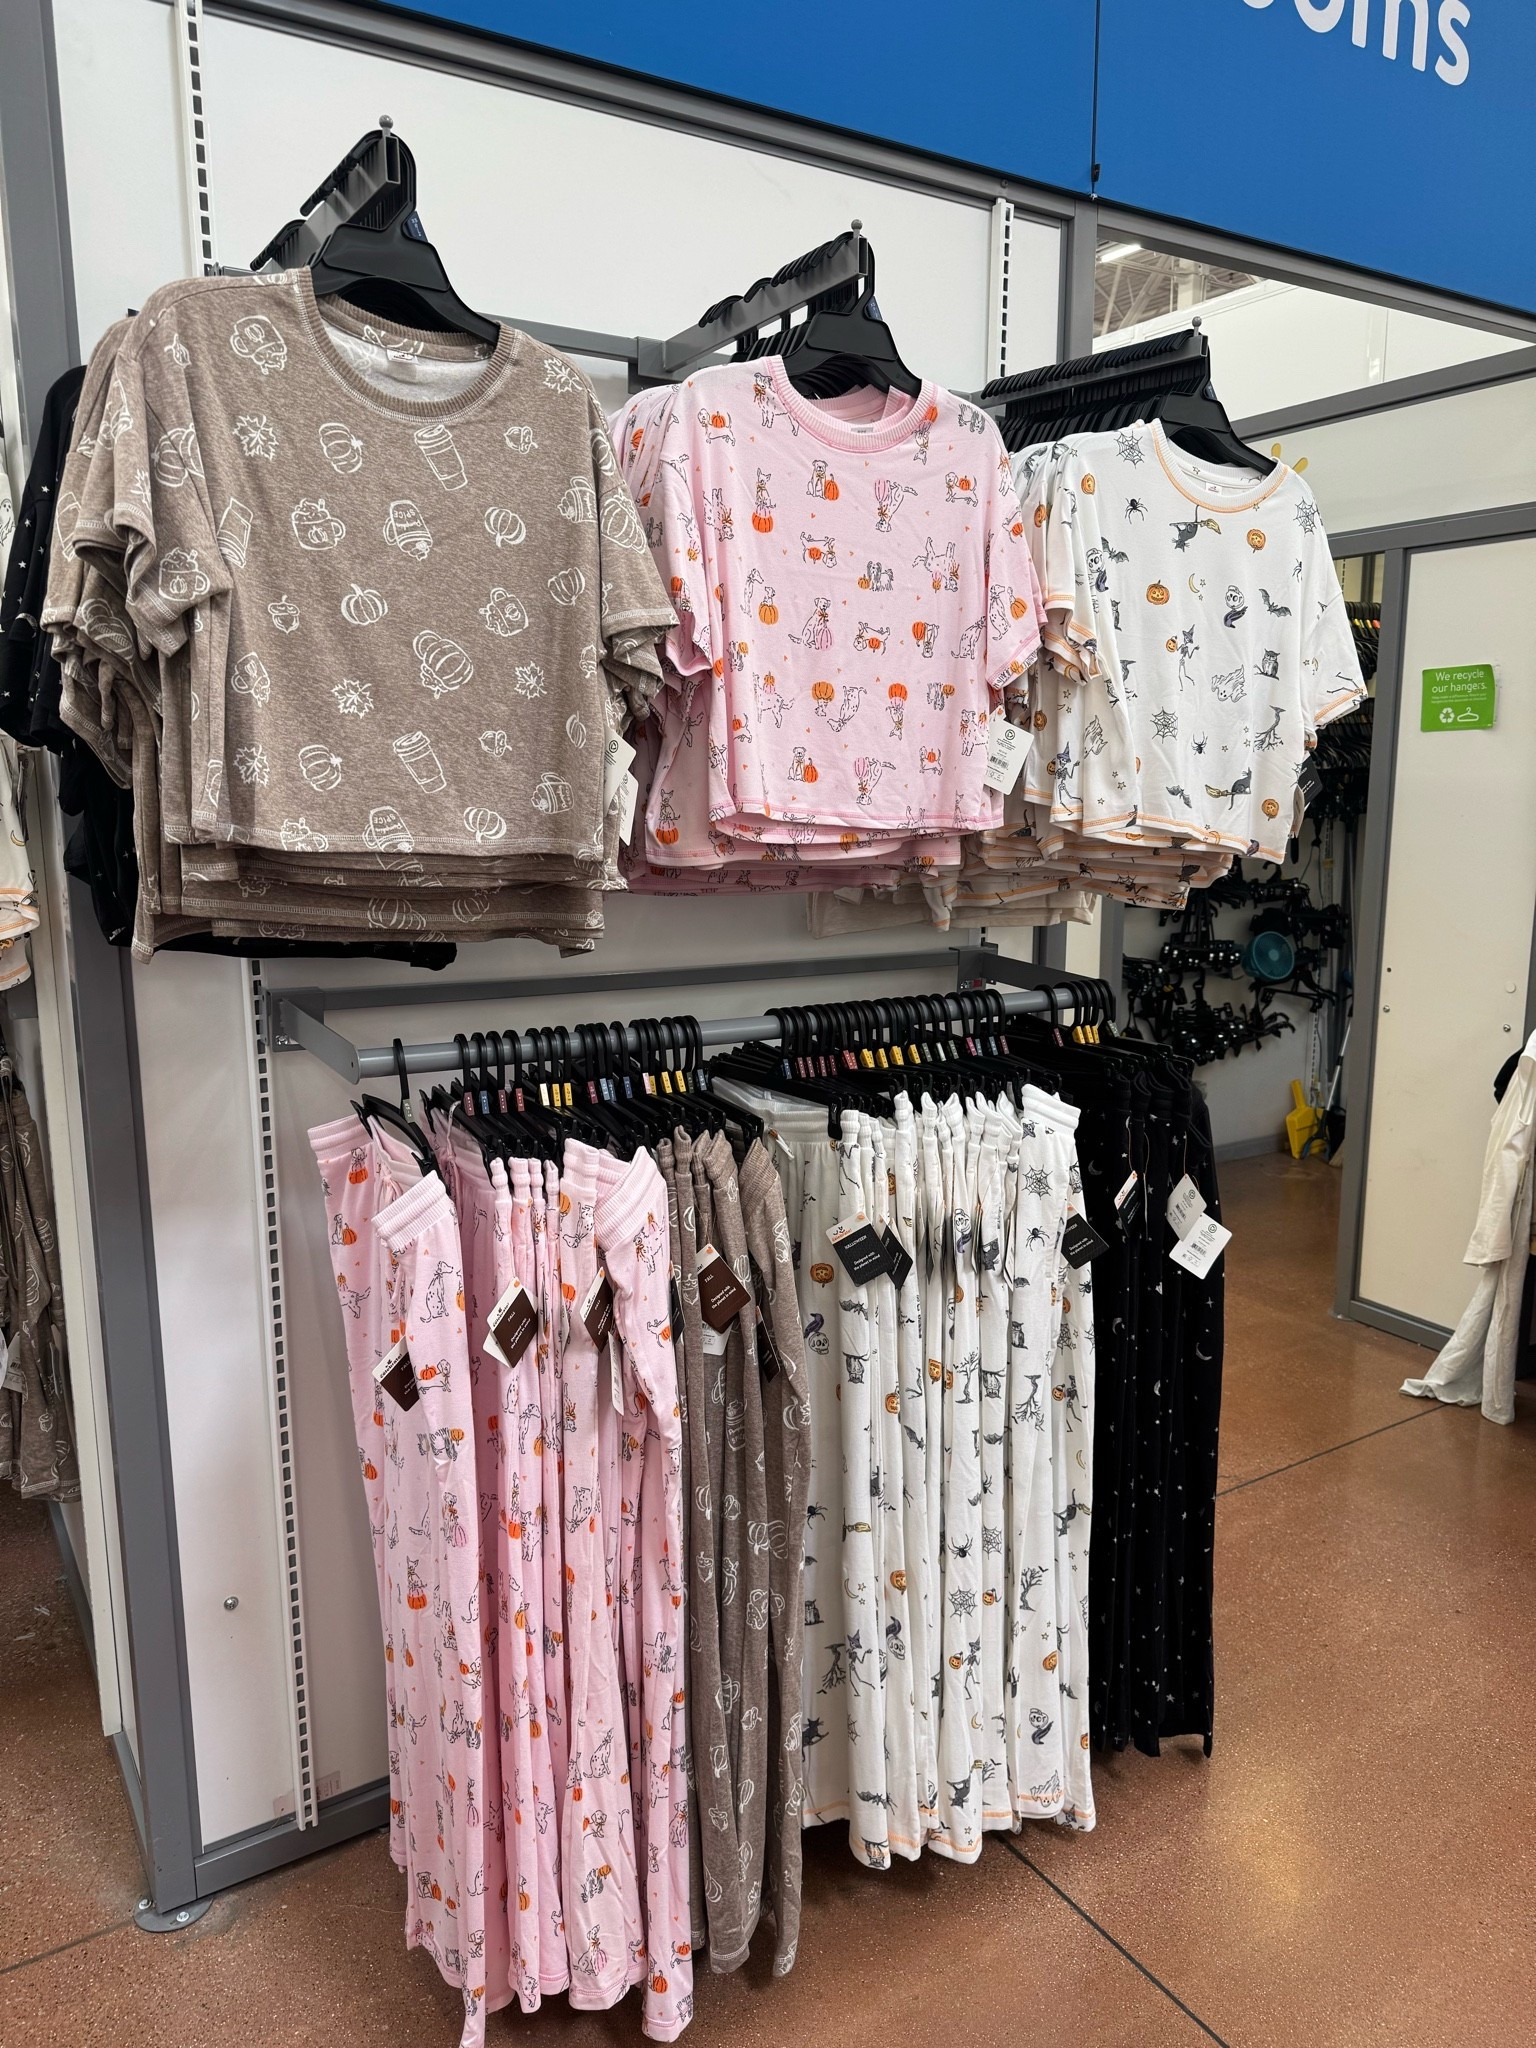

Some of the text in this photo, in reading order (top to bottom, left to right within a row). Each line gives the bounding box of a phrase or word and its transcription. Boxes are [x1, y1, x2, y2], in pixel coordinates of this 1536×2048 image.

[1242, 0, 1471, 86] ms
[394, 508, 416, 519] SPICE
[1435, 668, 1485, 682] We recycle
[1431, 682, 1488, 693] our hangers.
[374, 813, 396, 824] SPICE
[854, 1255, 868, 1265] Designed
[859, 1260, 869, 1268] planet
[711, 1290, 724, 1302] Designed
[717, 1296, 726, 1306] planet
[380, 1353, 403, 1378] Celebrate!
